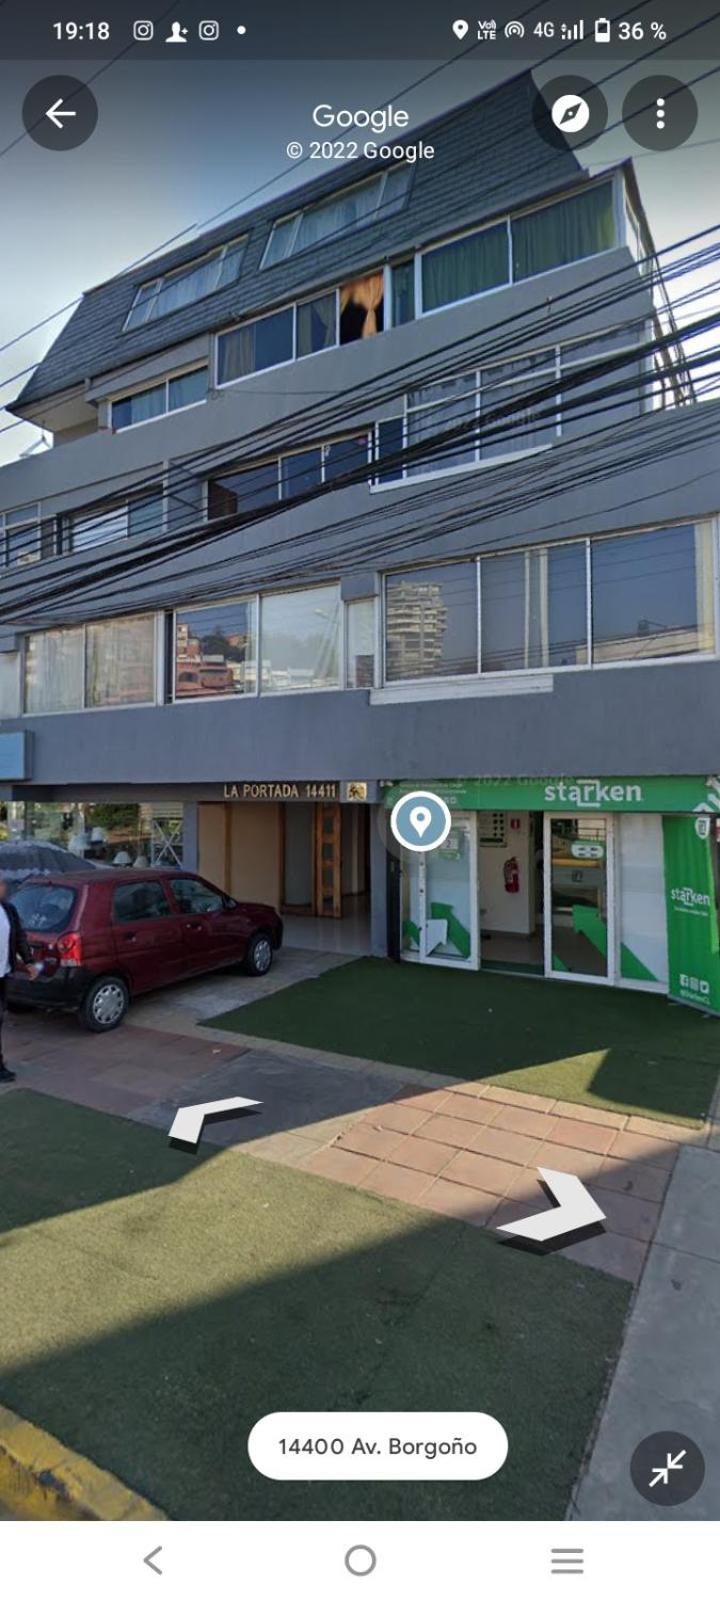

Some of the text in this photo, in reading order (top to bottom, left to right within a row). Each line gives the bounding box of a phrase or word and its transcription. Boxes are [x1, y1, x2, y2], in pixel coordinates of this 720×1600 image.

[224, 784, 336, 798] LA PORTADA 14411
[544, 779, 643, 807] starken
[671, 886, 711, 906] starken
